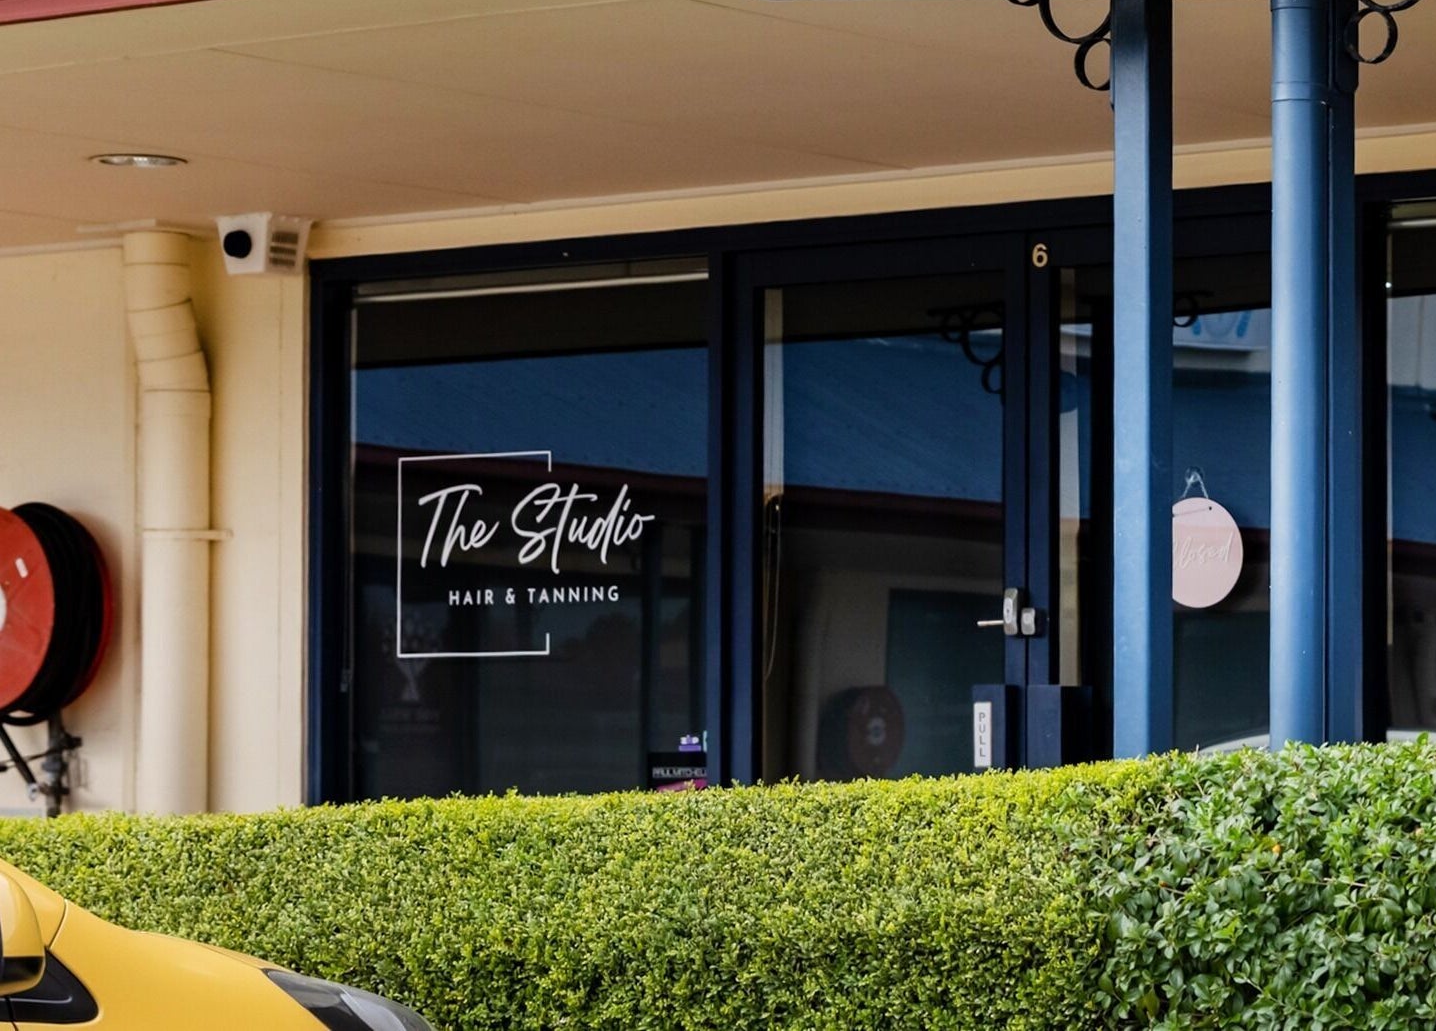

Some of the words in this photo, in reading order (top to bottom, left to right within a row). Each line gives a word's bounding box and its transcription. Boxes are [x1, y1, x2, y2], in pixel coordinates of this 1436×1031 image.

[1032, 244, 1048, 267] 6
[418, 484, 500, 568] The
[511, 482, 655, 575] Studio
[449, 589, 494, 606] HAIR
[505, 587, 516, 605] &
[527, 585, 619, 604] TANNING
[978, 712, 987, 758] PULL
